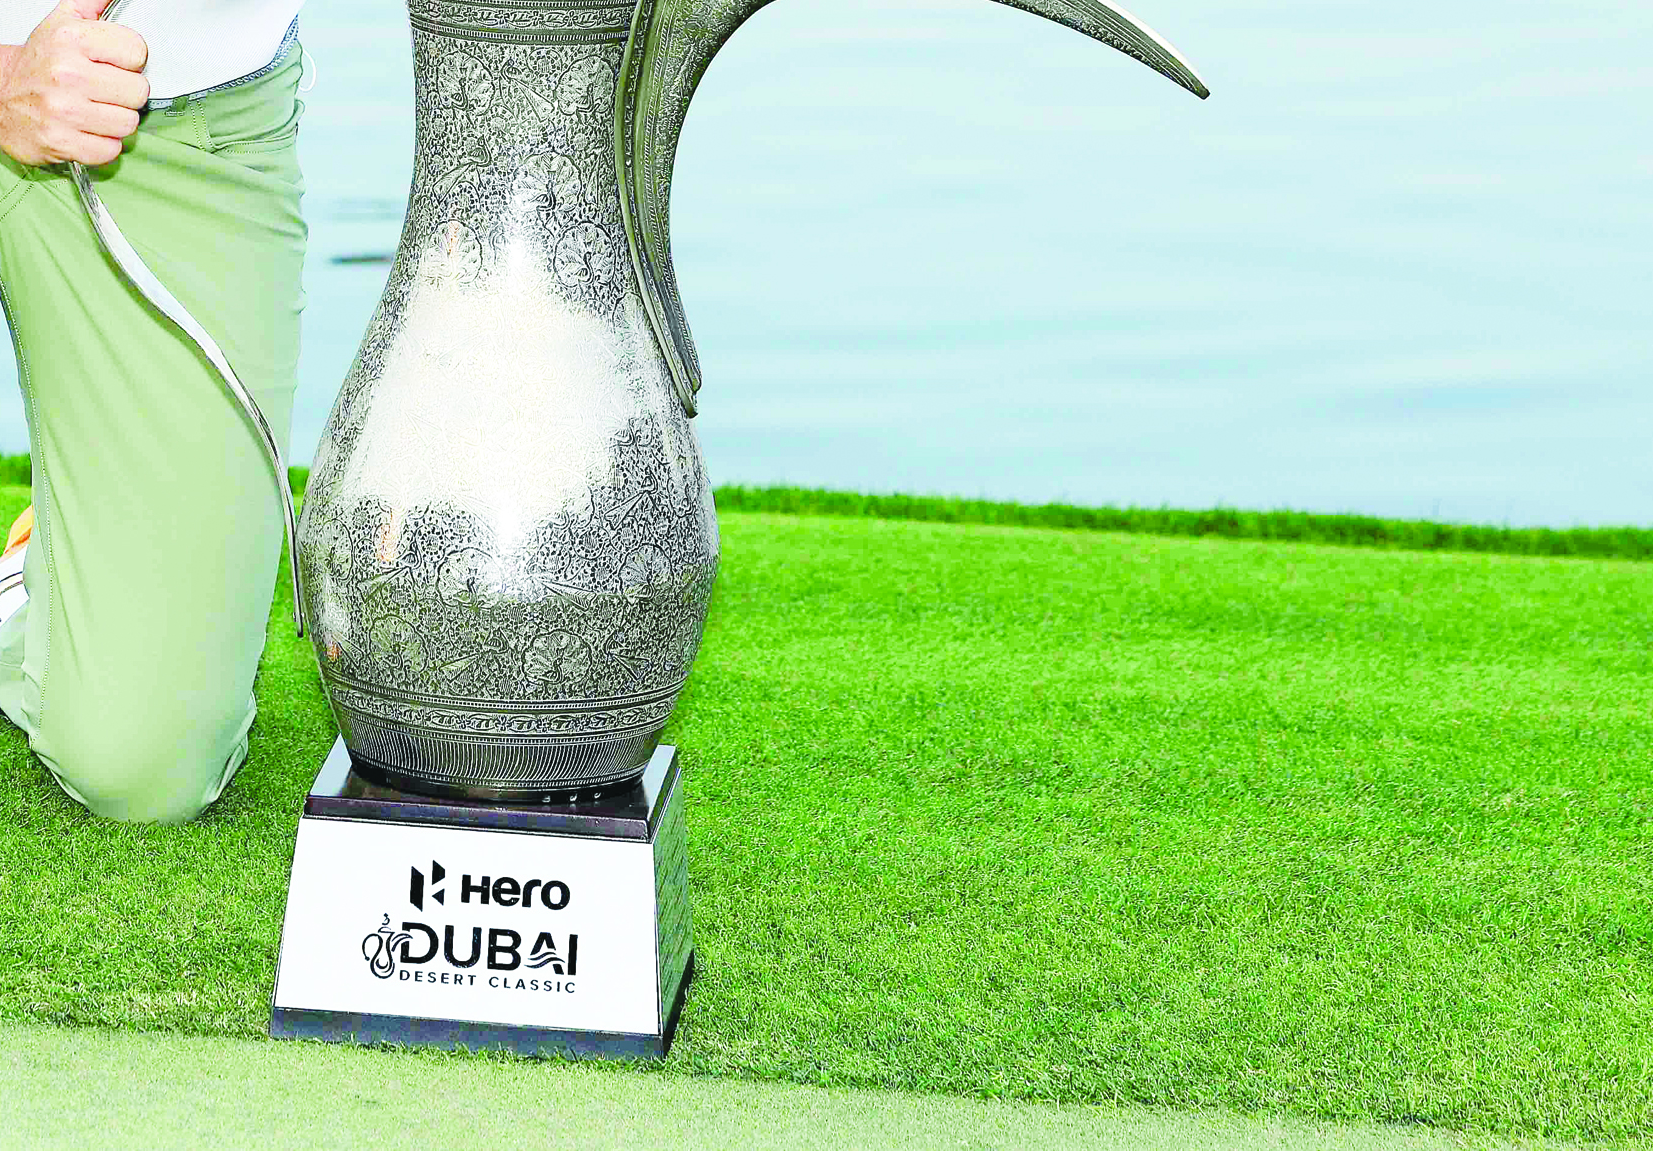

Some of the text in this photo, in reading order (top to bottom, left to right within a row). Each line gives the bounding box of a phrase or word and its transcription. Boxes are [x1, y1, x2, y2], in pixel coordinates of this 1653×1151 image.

[460, 874, 571, 911] Hero
[400, 921, 578, 976] DUBAI
[399, 969, 577, 994] DESERT CLASSIC
